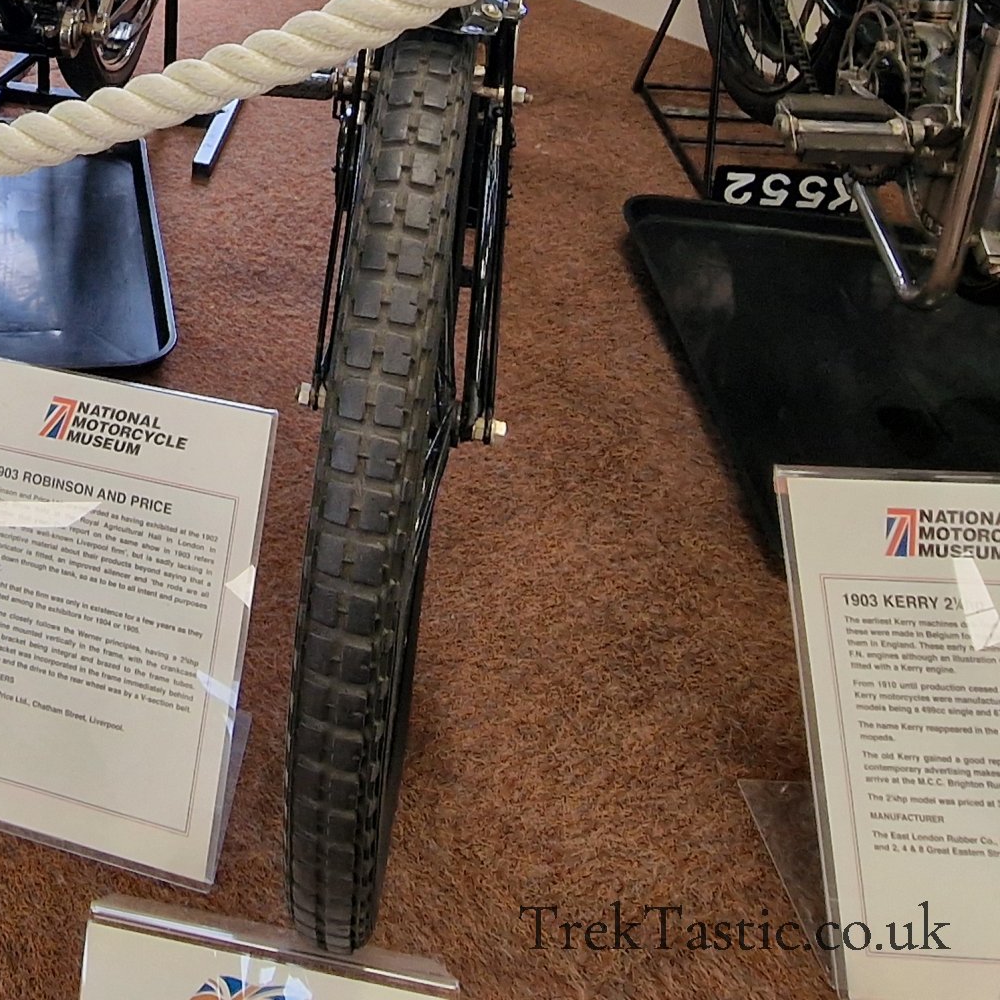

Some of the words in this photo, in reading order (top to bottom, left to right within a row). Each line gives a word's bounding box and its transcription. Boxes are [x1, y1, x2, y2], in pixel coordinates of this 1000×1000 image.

[77, 401, 161, 429] NATIONAL
[66, 430, 141, 456] MUSEUM
[72, 416, 188, 450] MOTORCYCLE
[22, 471, 94, 497] ROBINSON
[96, 487, 126, 504] AND
[130, 494, 172, 515] PRICE
[843, 593, 878, 607] 1903
[884, 594, 938, 610] KERRY
[870, 812, 945, 823] MANUFACTURER
